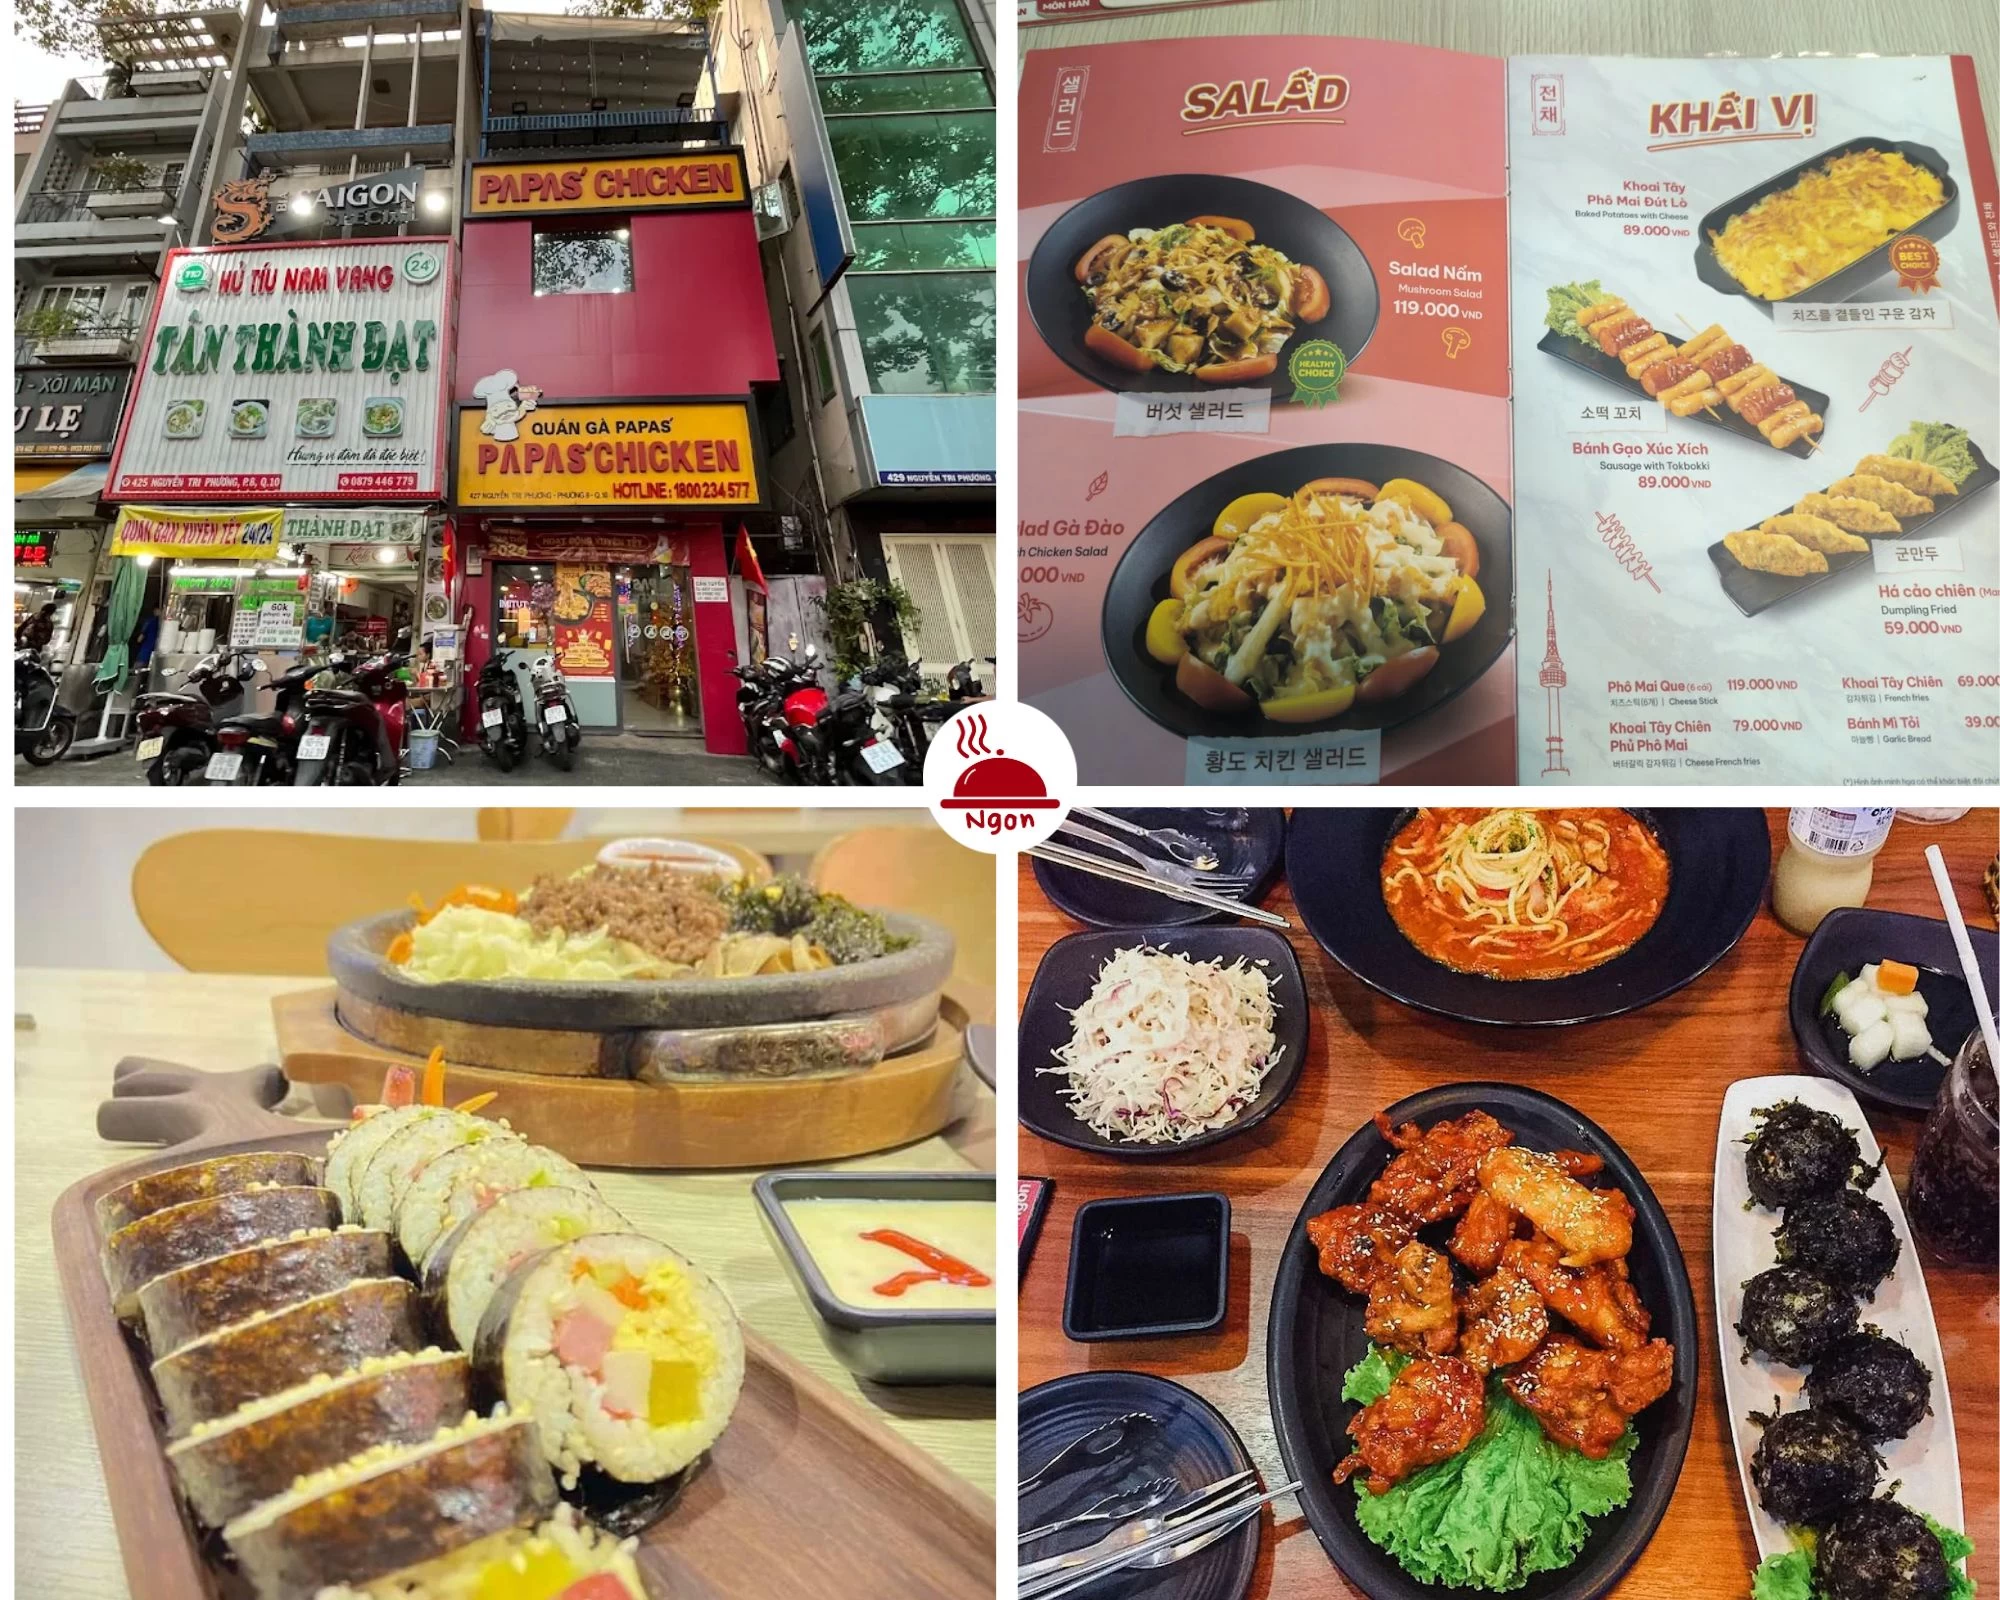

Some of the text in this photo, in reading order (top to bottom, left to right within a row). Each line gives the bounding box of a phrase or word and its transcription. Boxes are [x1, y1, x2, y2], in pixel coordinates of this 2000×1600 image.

[1181, 67, 1350, 122] SALAD
[1051, 75, 1081, 137] 샐러드
[1539, 84, 1558, 124] 전채
[1769, 92, 1816, 136] VỊ
[594, 163, 734, 197] CHICKEN
[1623, 180, 1686, 195] Khoai Tây
[1587, 194, 1689, 209] Phô Mai Đút Lò
[1602, 210, 1639, 219] Potatoes
[1640, 211, 1658, 219] with
[1659, 212, 1690, 221] Cheese
[1623, 224, 1691, 237] 89.000 VND
[1899, 252, 1930, 261] BEST
[1389, 261, 1482, 282] Salad Nấm
[1900, 261, 1931, 270] CHOICE
[283, 266, 330, 294] NAM
[336, 265, 394, 292] VANG
[1398, 283, 1483, 299] Mushroom Salad
[1394, 300, 1483, 320] 119.000 VND
[1793, 309, 1832, 322] 치즈를
[1879, 309, 1906, 321] 구운
[1909, 307, 1936, 321] 감자
[151, 308, 437, 385] TÂN THÀNH ĐẠT
[1299, 360, 1336, 369] HEALTHY
[1298, 369, 1335, 378] CHOICE
[38, 373, 68, 394] XÔI
[1146, 401, 1244, 421] 버섯 샐러드
[1581, 405, 1642, 421] 소떡 꼬치
[34, 404, 83, 438] LẸ
[532, 420, 581, 435] QUÁN
[585, 418, 611, 434] GÀ
[1572, 442, 1709, 458] Bánh Gạo Xúc Xích
[1599, 461, 1711, 473] Sausage with Tokbokki
[131, 478, 148, 487] 425
[260, 477, 281, 487] Q.10
[350, 475, 415, 486] 0879 446 779
[887, 473, 906, 482] 429
[943, 474, 957, 482] TRI
[1638, 475, 1712, 489] 89.000 VND
[674, 482, 701, 498] 1800
[703, 482, 727, 498] 234
[728, 482, 750, 498] 577
[220, 515, 241, 544] TẾT
[241, 522, 274, 544] 24/24
[288, 514, 385, 542] THÀNH ĐẠT
[1018, 518, 1125, 537] lad Gà Đào
[1028, 546, 1108, 557] Chicken Salad
[1895, 546, 1939, 562] 군만두
[1061, 572, 1085, 583] VND
[1879, 583, 1976, 598] Há cảo chiên
[1881, 604, 1957, 617] Dumpling Fried
[1884, 620, 1963, 635] 59.000 VND
[1608, 681, 1632, 693] Phô
[1635, 681, 1658, 692] Mai
[1660, 680, 1685, 693] Que
[1728, 678, 1798, 691] 119.000 VND
[1842, 676, 1943, 690] Khoai Tây Chiên
[1668, 696, 1719, 705] Cheese Stick
[1884, 694, 1911, 702] French
[1609, 720, 1712, 736] Khoai Tây Chiên
[1733, 719, 1803, 732] 79.000 VND
[1847, 715, 1920, 729] Bánh Mì Tỏi
[1610, 738, 1688, 752] Phủ Phô Mai
[1883, 735, 1906, 743] Garlic
[1204, 747, 1367, 774] 황도 치킨 샐러드
[1685, 756, 1760, 767] Cheese French fries
